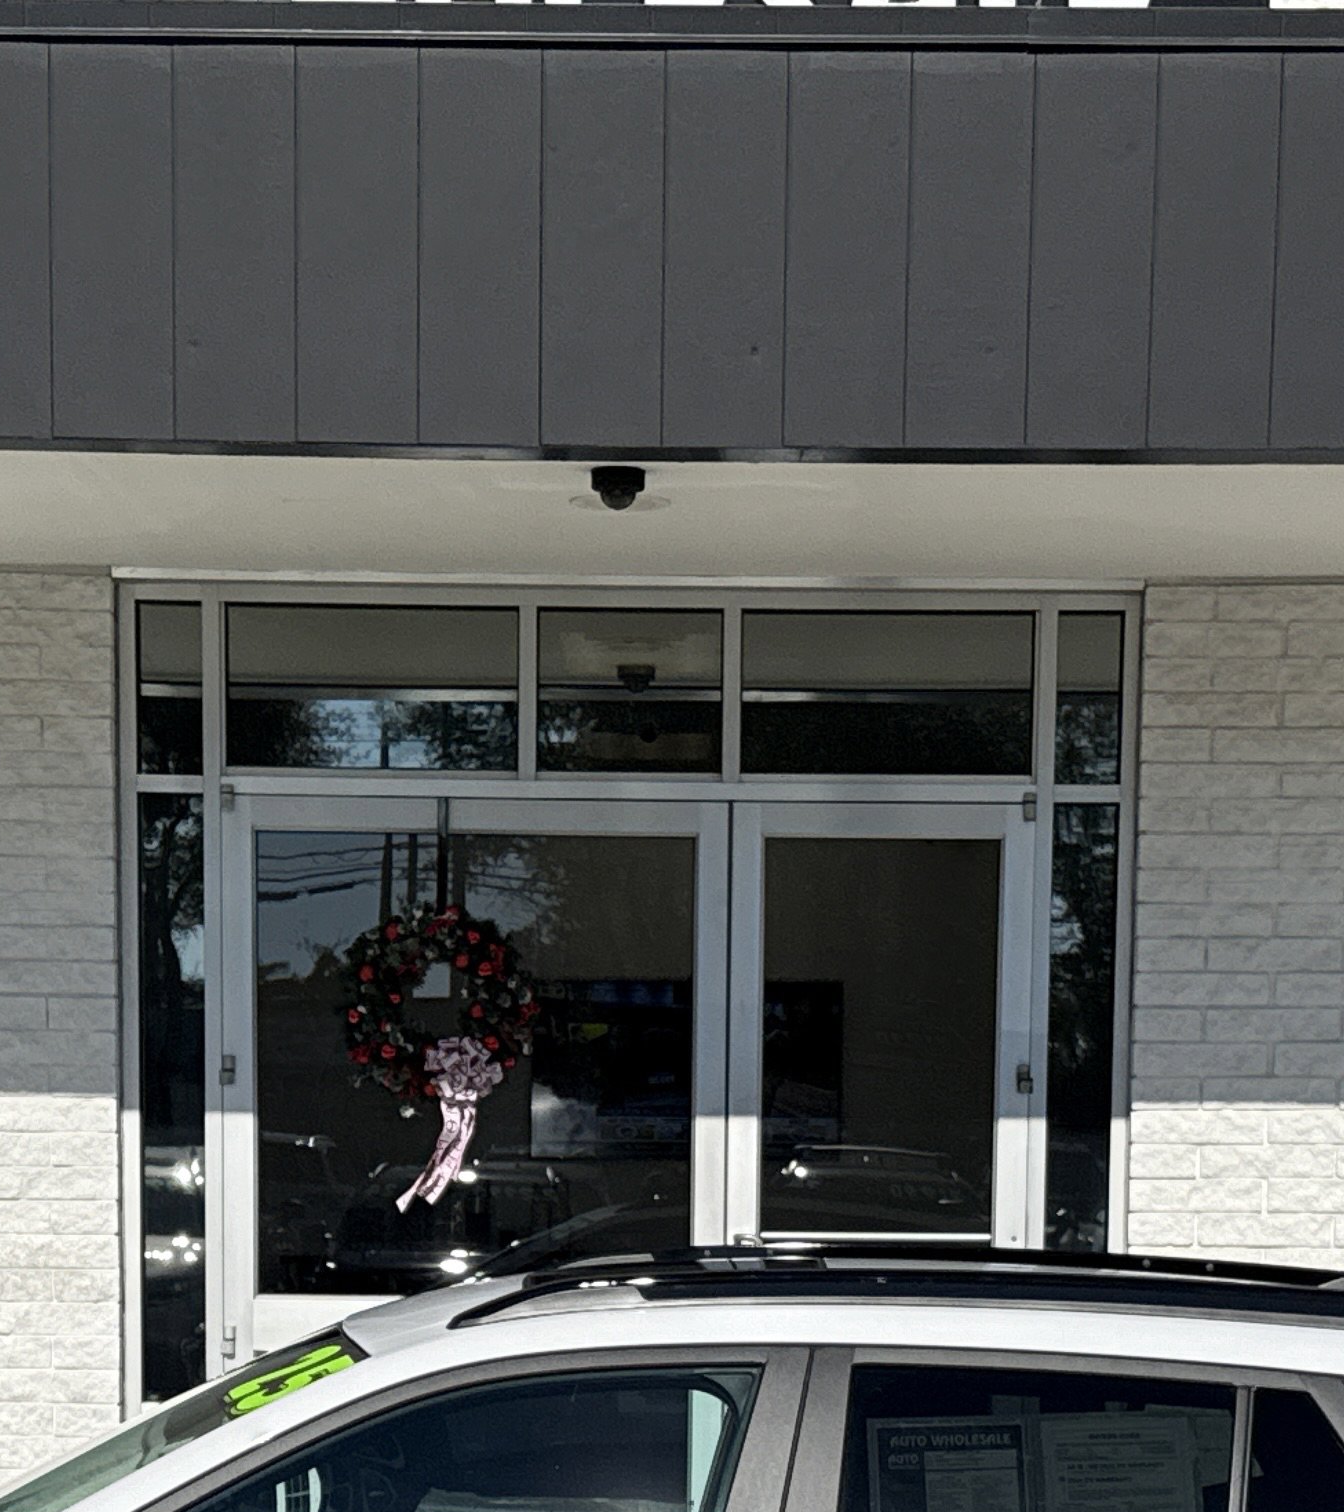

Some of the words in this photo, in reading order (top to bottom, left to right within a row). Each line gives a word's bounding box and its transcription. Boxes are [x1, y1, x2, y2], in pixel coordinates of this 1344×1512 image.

[227, 1344, 355, 1412] 25
[890, 1435, 927, 1448] AUTO
[930, 1433, 1012, 1446] WHOLESALE
